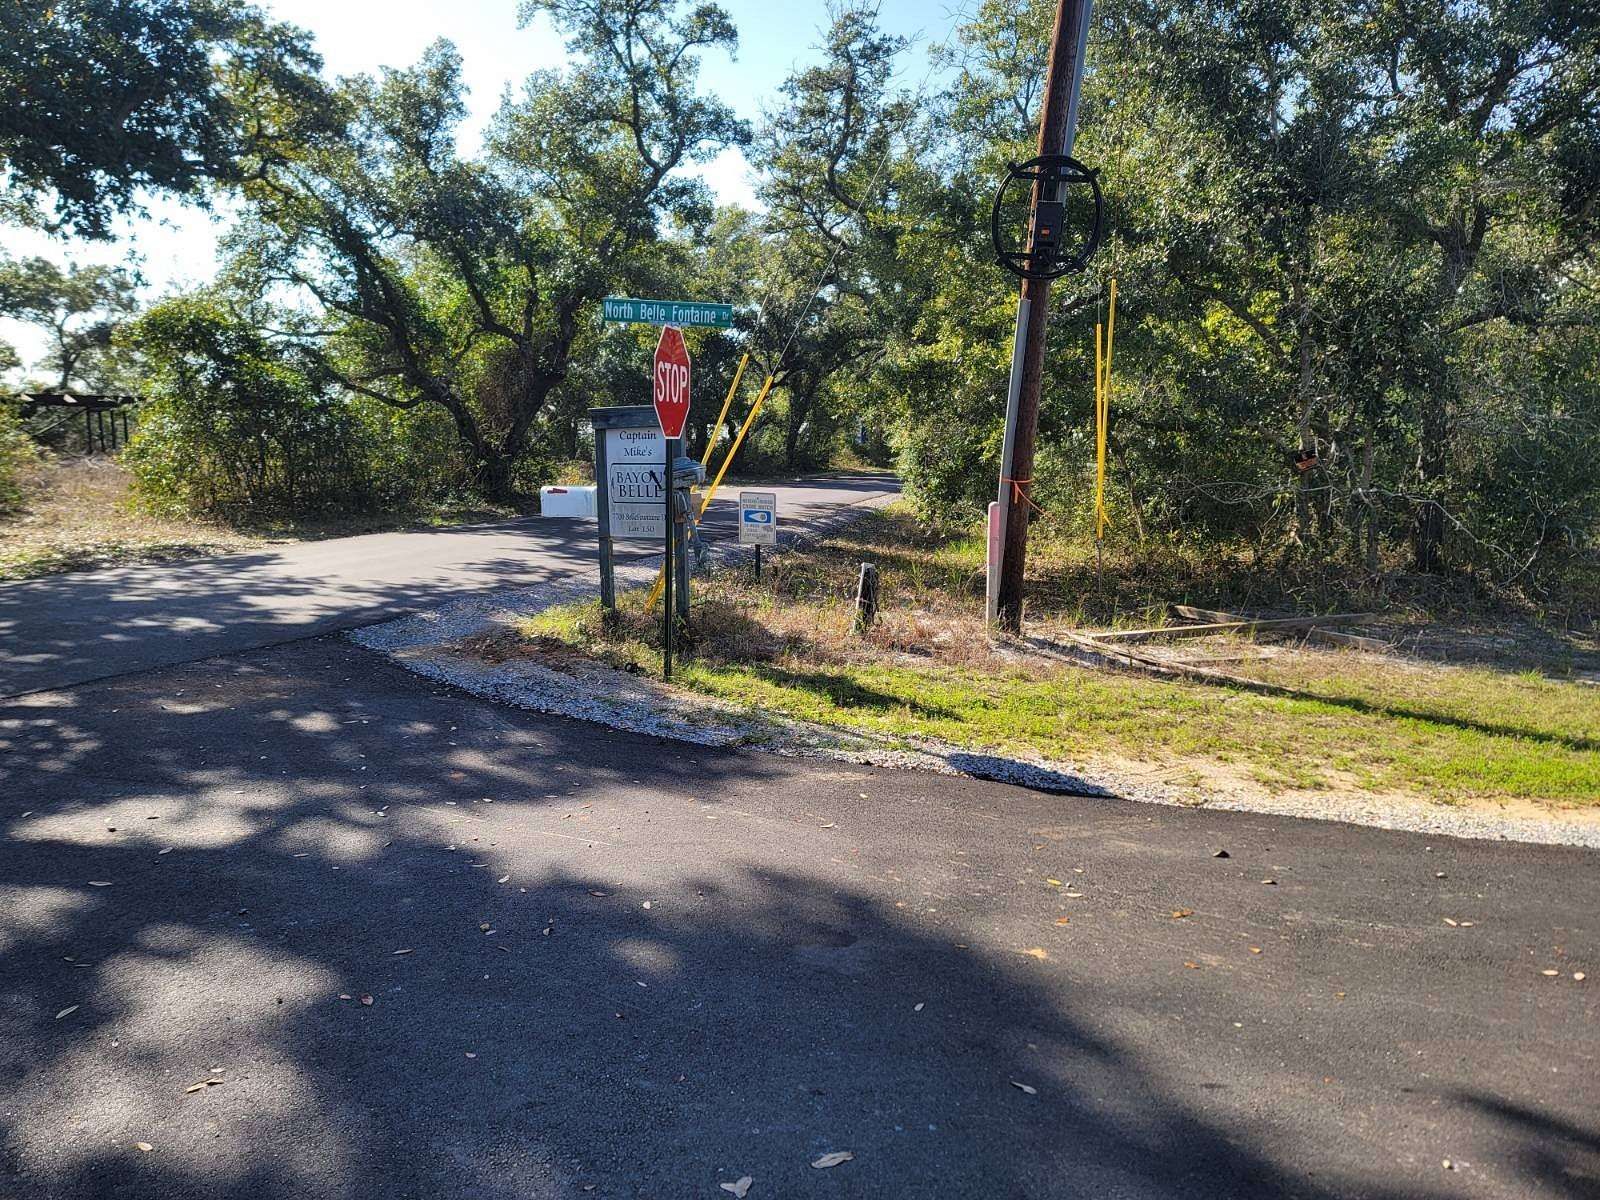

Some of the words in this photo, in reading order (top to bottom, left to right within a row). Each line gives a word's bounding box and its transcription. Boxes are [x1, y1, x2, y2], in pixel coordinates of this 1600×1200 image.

[605, 301, 633, 319] North
[640, 303, 665, 321] Belle
[672, 305, 716, 323] Fontaine
[722, 311, 730, 320] Dr
[657, 361, 688, 403] STOP
[619, 431, 656, 444] Captain
[624, 446, 653, 457] Mike's
[616, 471, 663, 484] BAYOU
[619, 485, 662, 498] BELLE
